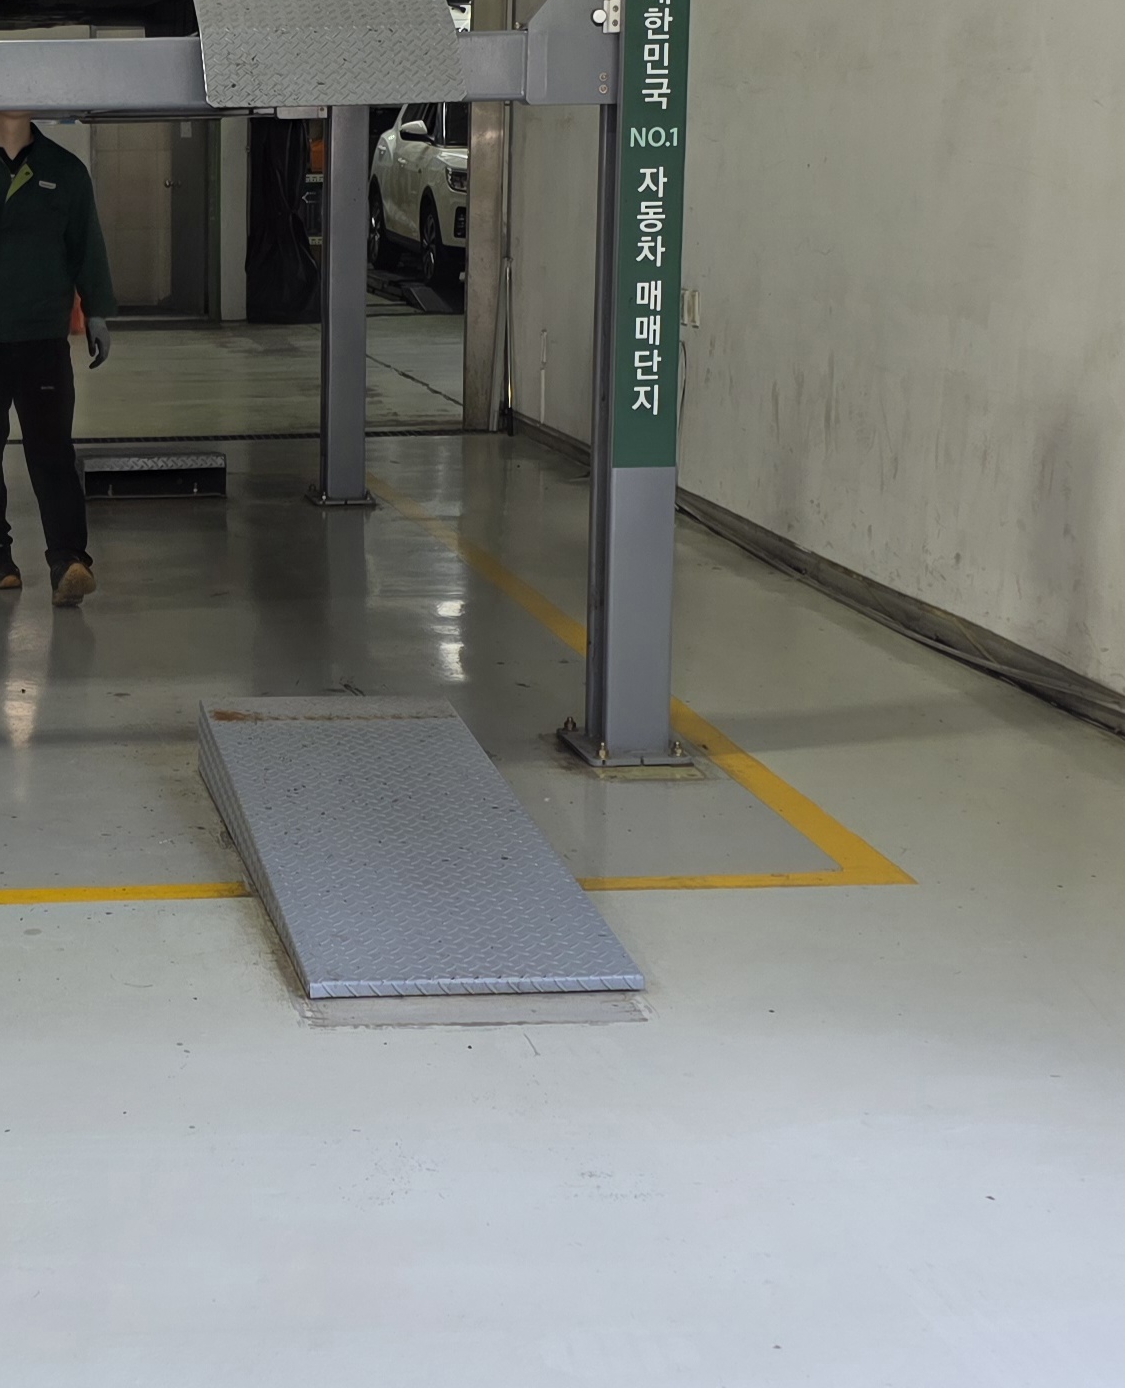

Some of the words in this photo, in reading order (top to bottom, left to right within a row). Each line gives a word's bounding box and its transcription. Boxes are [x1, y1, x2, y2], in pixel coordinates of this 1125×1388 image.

[630, 127, 679, 148] NO.1
[636, 166, 668, 268] 자동차
[631, 280, 662, 415] 매매단지
